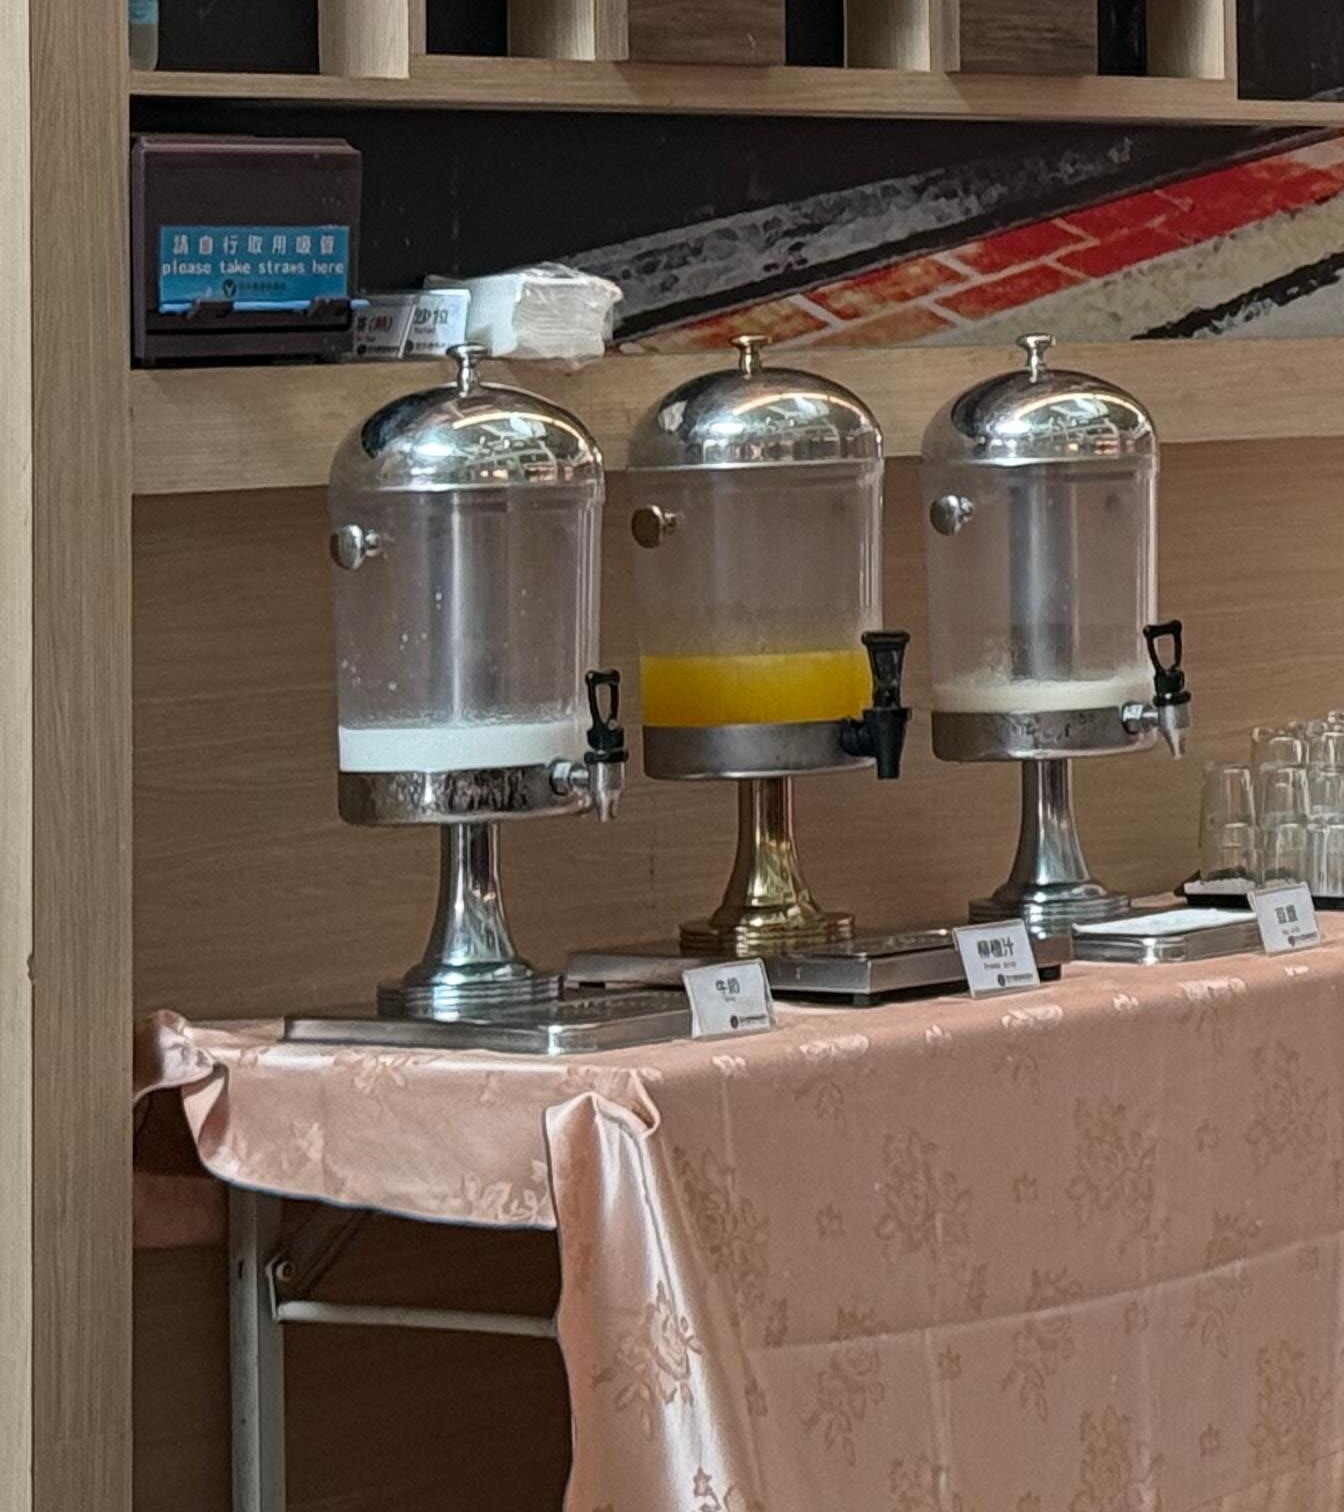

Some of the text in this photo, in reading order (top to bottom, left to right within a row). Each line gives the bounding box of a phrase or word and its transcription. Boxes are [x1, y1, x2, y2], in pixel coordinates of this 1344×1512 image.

[162, 258, 345, 276] please take straws here
